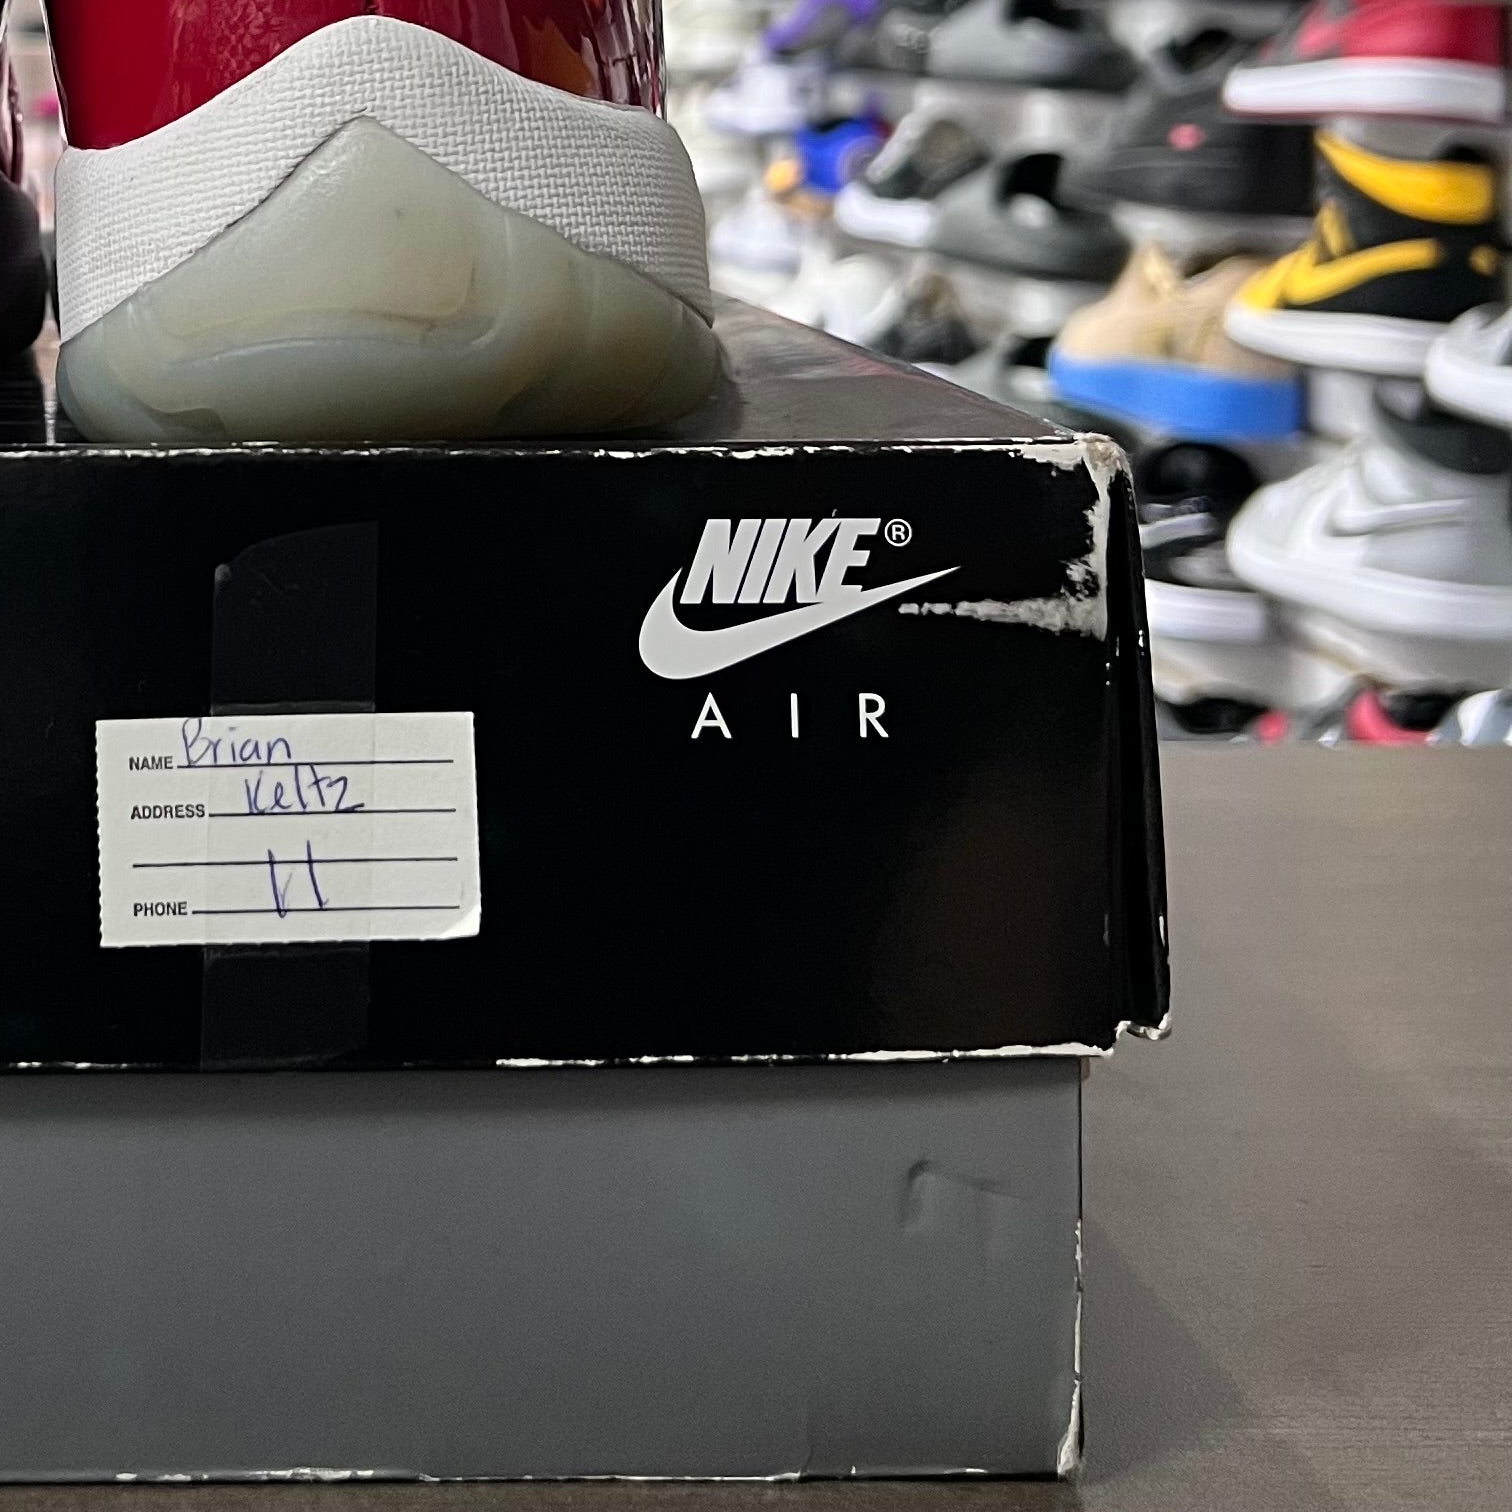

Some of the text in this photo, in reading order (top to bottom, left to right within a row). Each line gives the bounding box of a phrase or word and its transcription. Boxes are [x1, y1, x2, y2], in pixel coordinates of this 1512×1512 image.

[679, 518, 882, 605] NIKE
[690, 691, 890, 739] AIR
[181, 717, 293, 767] Brian
[128, 755, 174, 771] NAME
[130, 804, 206, 820] ADDRESS
[132, 901, 189, 917] PHONE
